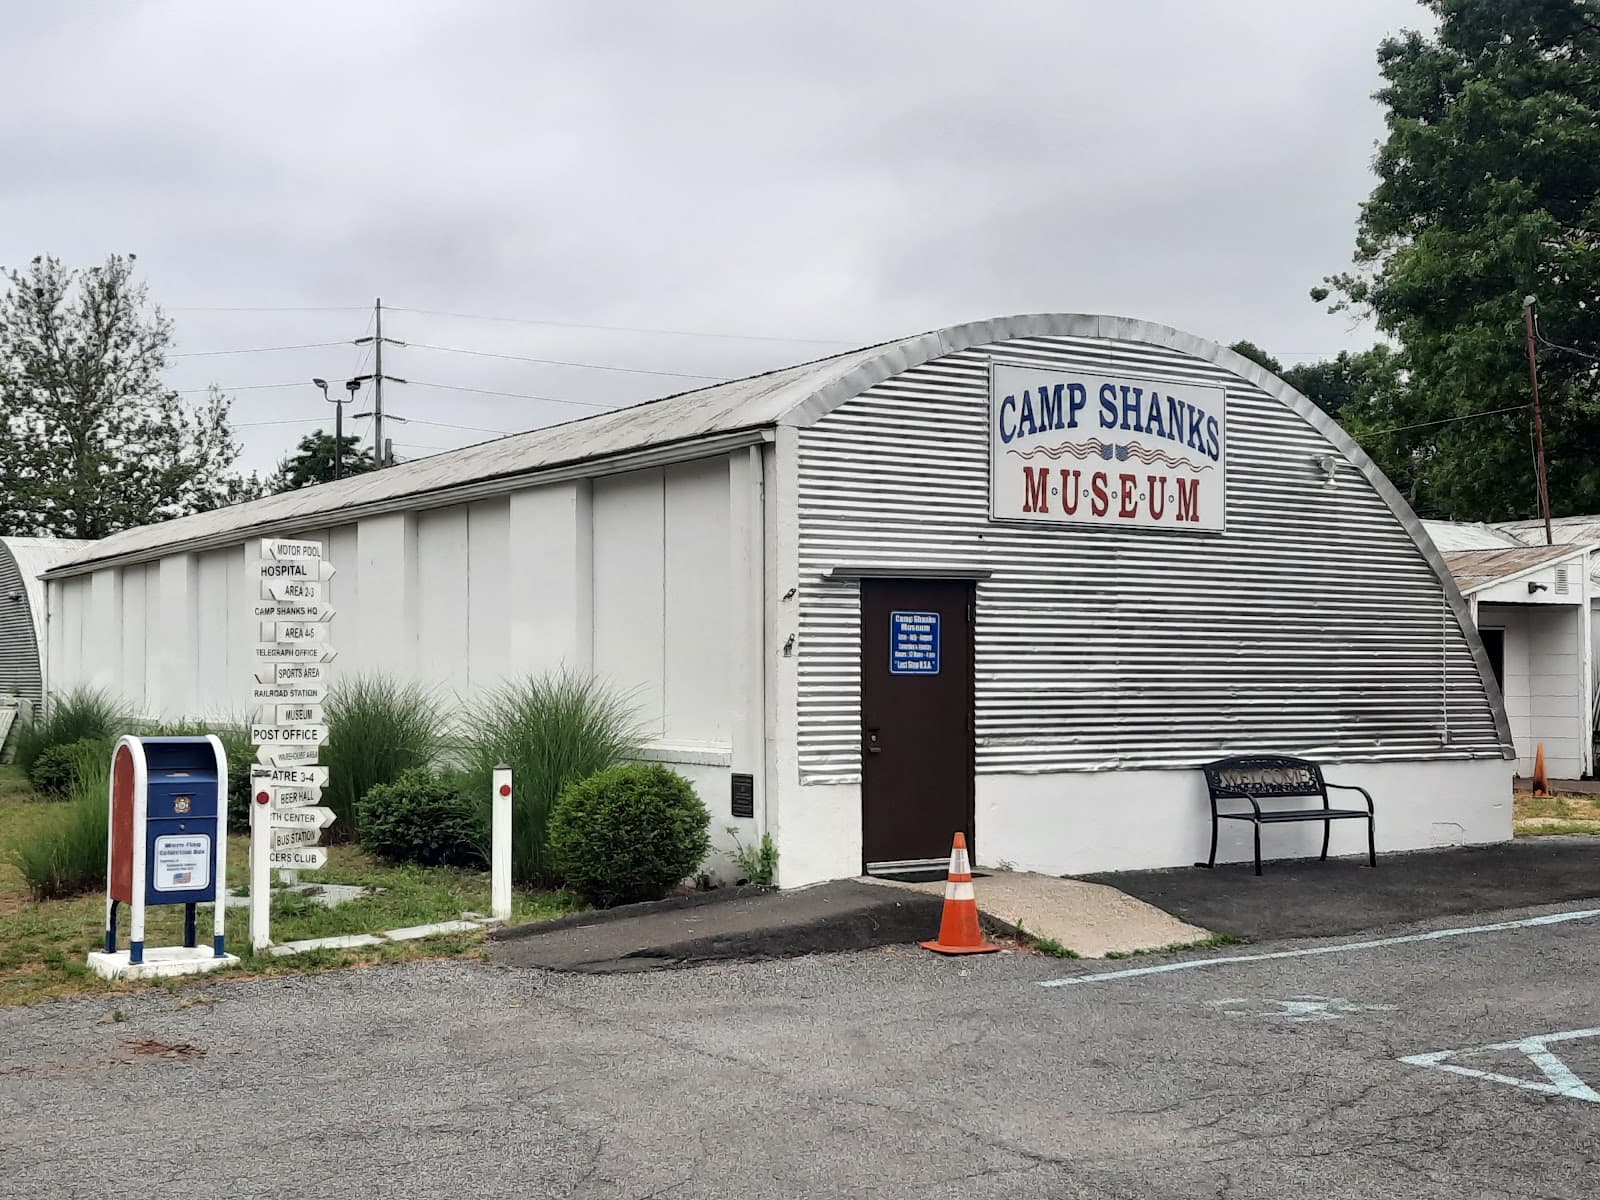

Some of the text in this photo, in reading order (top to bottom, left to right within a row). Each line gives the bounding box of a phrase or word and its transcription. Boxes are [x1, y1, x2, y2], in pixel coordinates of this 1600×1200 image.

[1000, 382, 1219, 462] CAMP SHANKS
[1022, 466, 1200, 522] MUSEUM
[277, 544, 320, 557] MOTOR POOL
[260, 565, 307, 577] HOSPITAL
[284, 585, 315, 598] AREA 2-3
[254, 606, 318, 616] CAMP SHANKS HQ
[285, 627, 303, 639] AREA
[256, 648, 318, 657] TELEGRAPH OFFICE
[278, 667, 320, 679] SPORTS AREA
[254, 689, 318, 698] RAILROAD STATION
[285, 709, 312, 721] MUSEUM
[253, 729, 318, 741] POST OFFICE
[300, 771, 315, 783] 3-4
[281, 790, 314, 805] BEER HALL
[284, 813, 316, 823] CENTER
[277, 830, 316, 847] BUS STATION
[294, 853, 317, 863] CLUB
